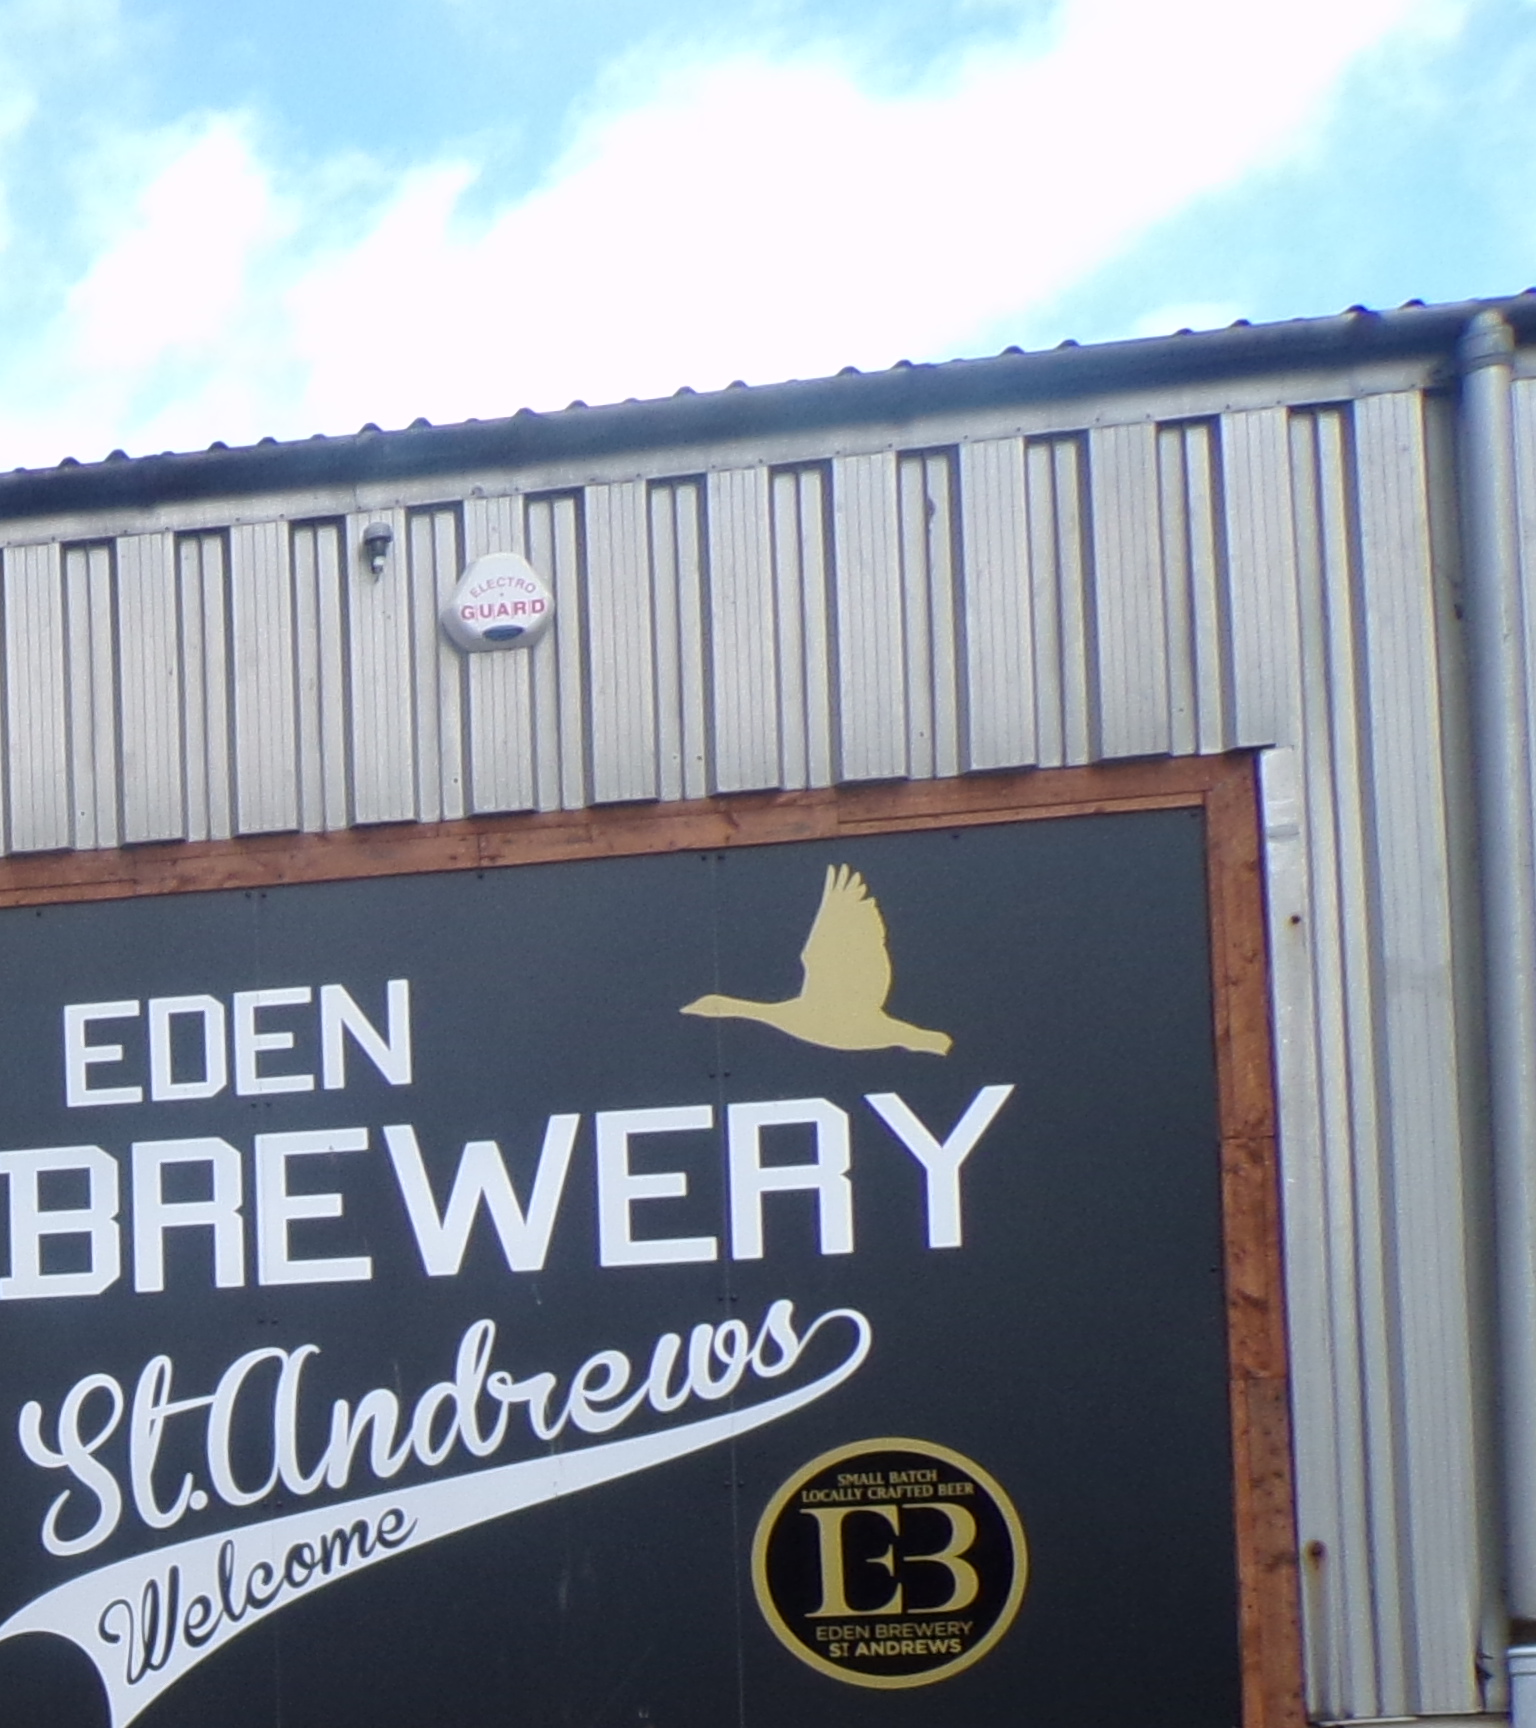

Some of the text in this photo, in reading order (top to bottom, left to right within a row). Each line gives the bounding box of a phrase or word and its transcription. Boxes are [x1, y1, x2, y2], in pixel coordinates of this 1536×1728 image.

[469, 576, 536, 598] ELECTRO
[460, 598, 545, 620] GUARD
[63, 979, 412, 1108] EDEN
[837, 1469, 938, 1487] SMALL BATCH
[801, 1482, 974, 1503] LOCALLY CRAFTED BEER
[98, 1506, 418, 1685] Welcome
[816, 1620, 974, 1641] EDEN BREWERY
[829, 1638, 962, 1658] ST ANDREWS
